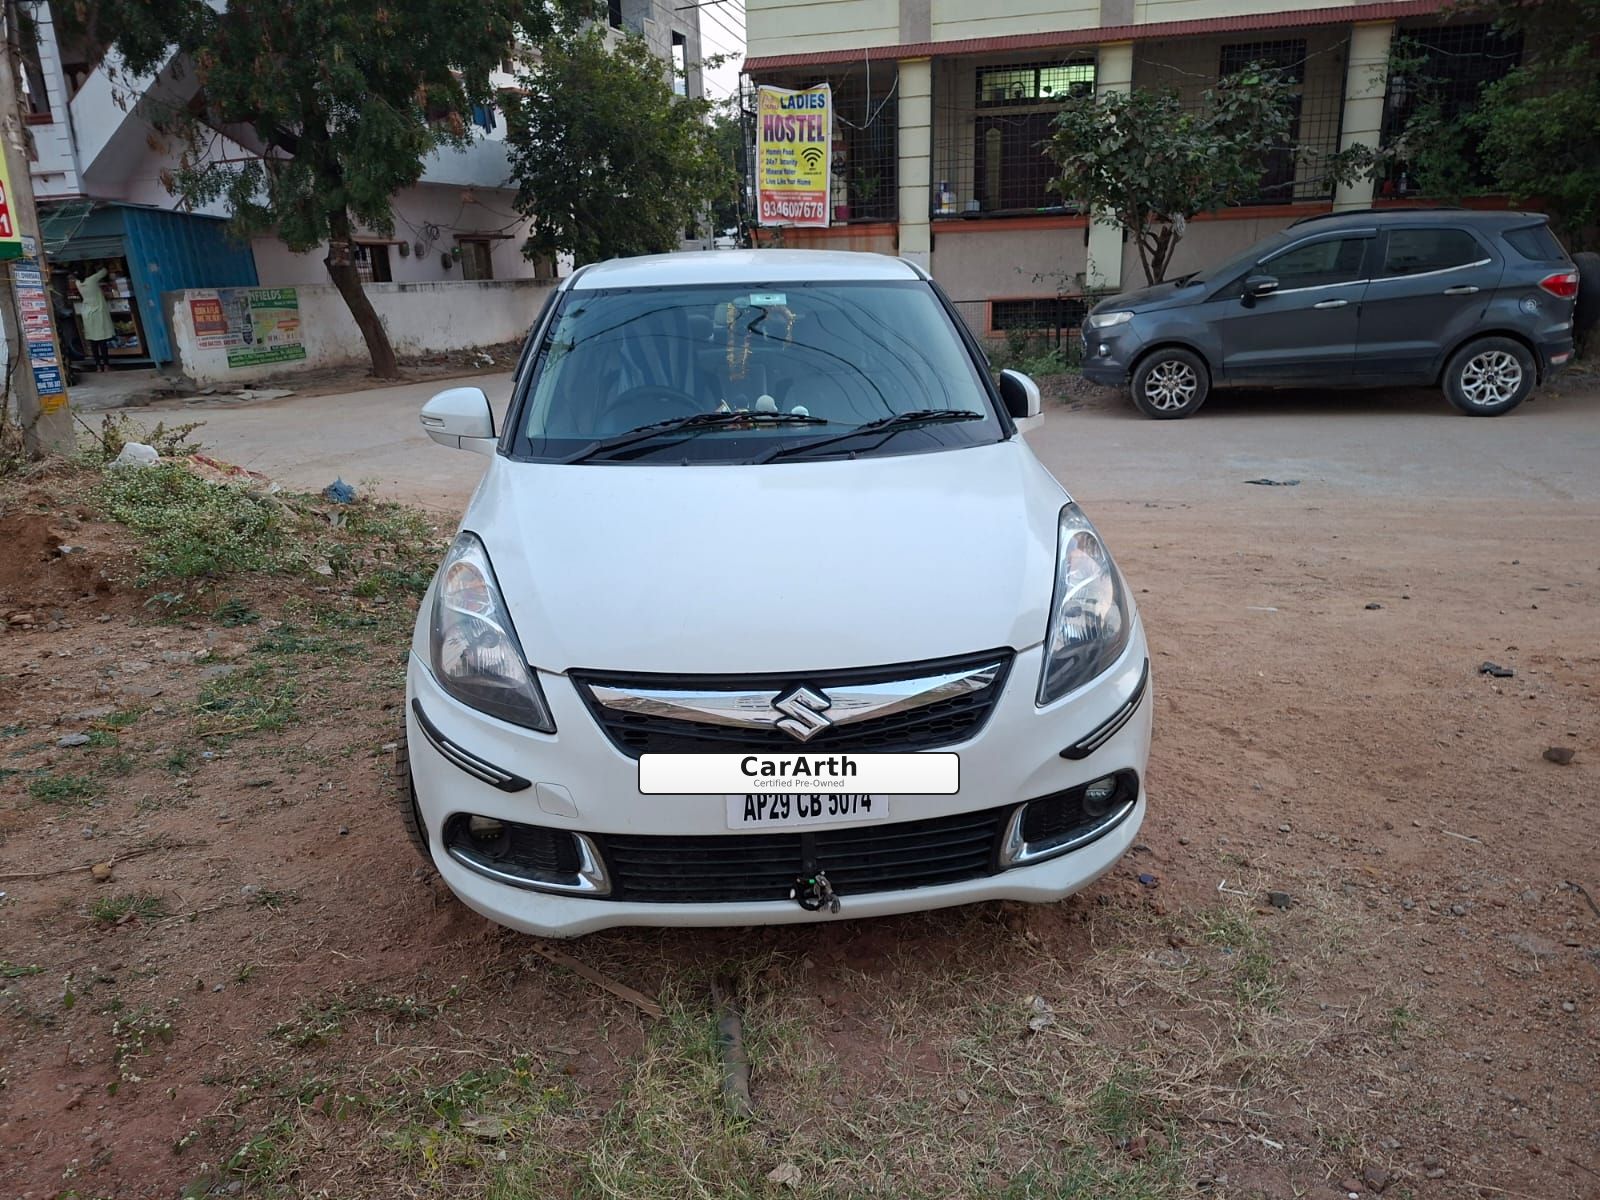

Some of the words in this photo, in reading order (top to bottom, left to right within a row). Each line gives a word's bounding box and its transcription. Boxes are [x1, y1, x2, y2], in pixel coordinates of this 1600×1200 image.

[780, 93, 825, 109] LADIES
[763, 114, 825, 143] HOSTEL
[743, 794, 791, 822] AP29
[797, 794, 822, 818] CB
